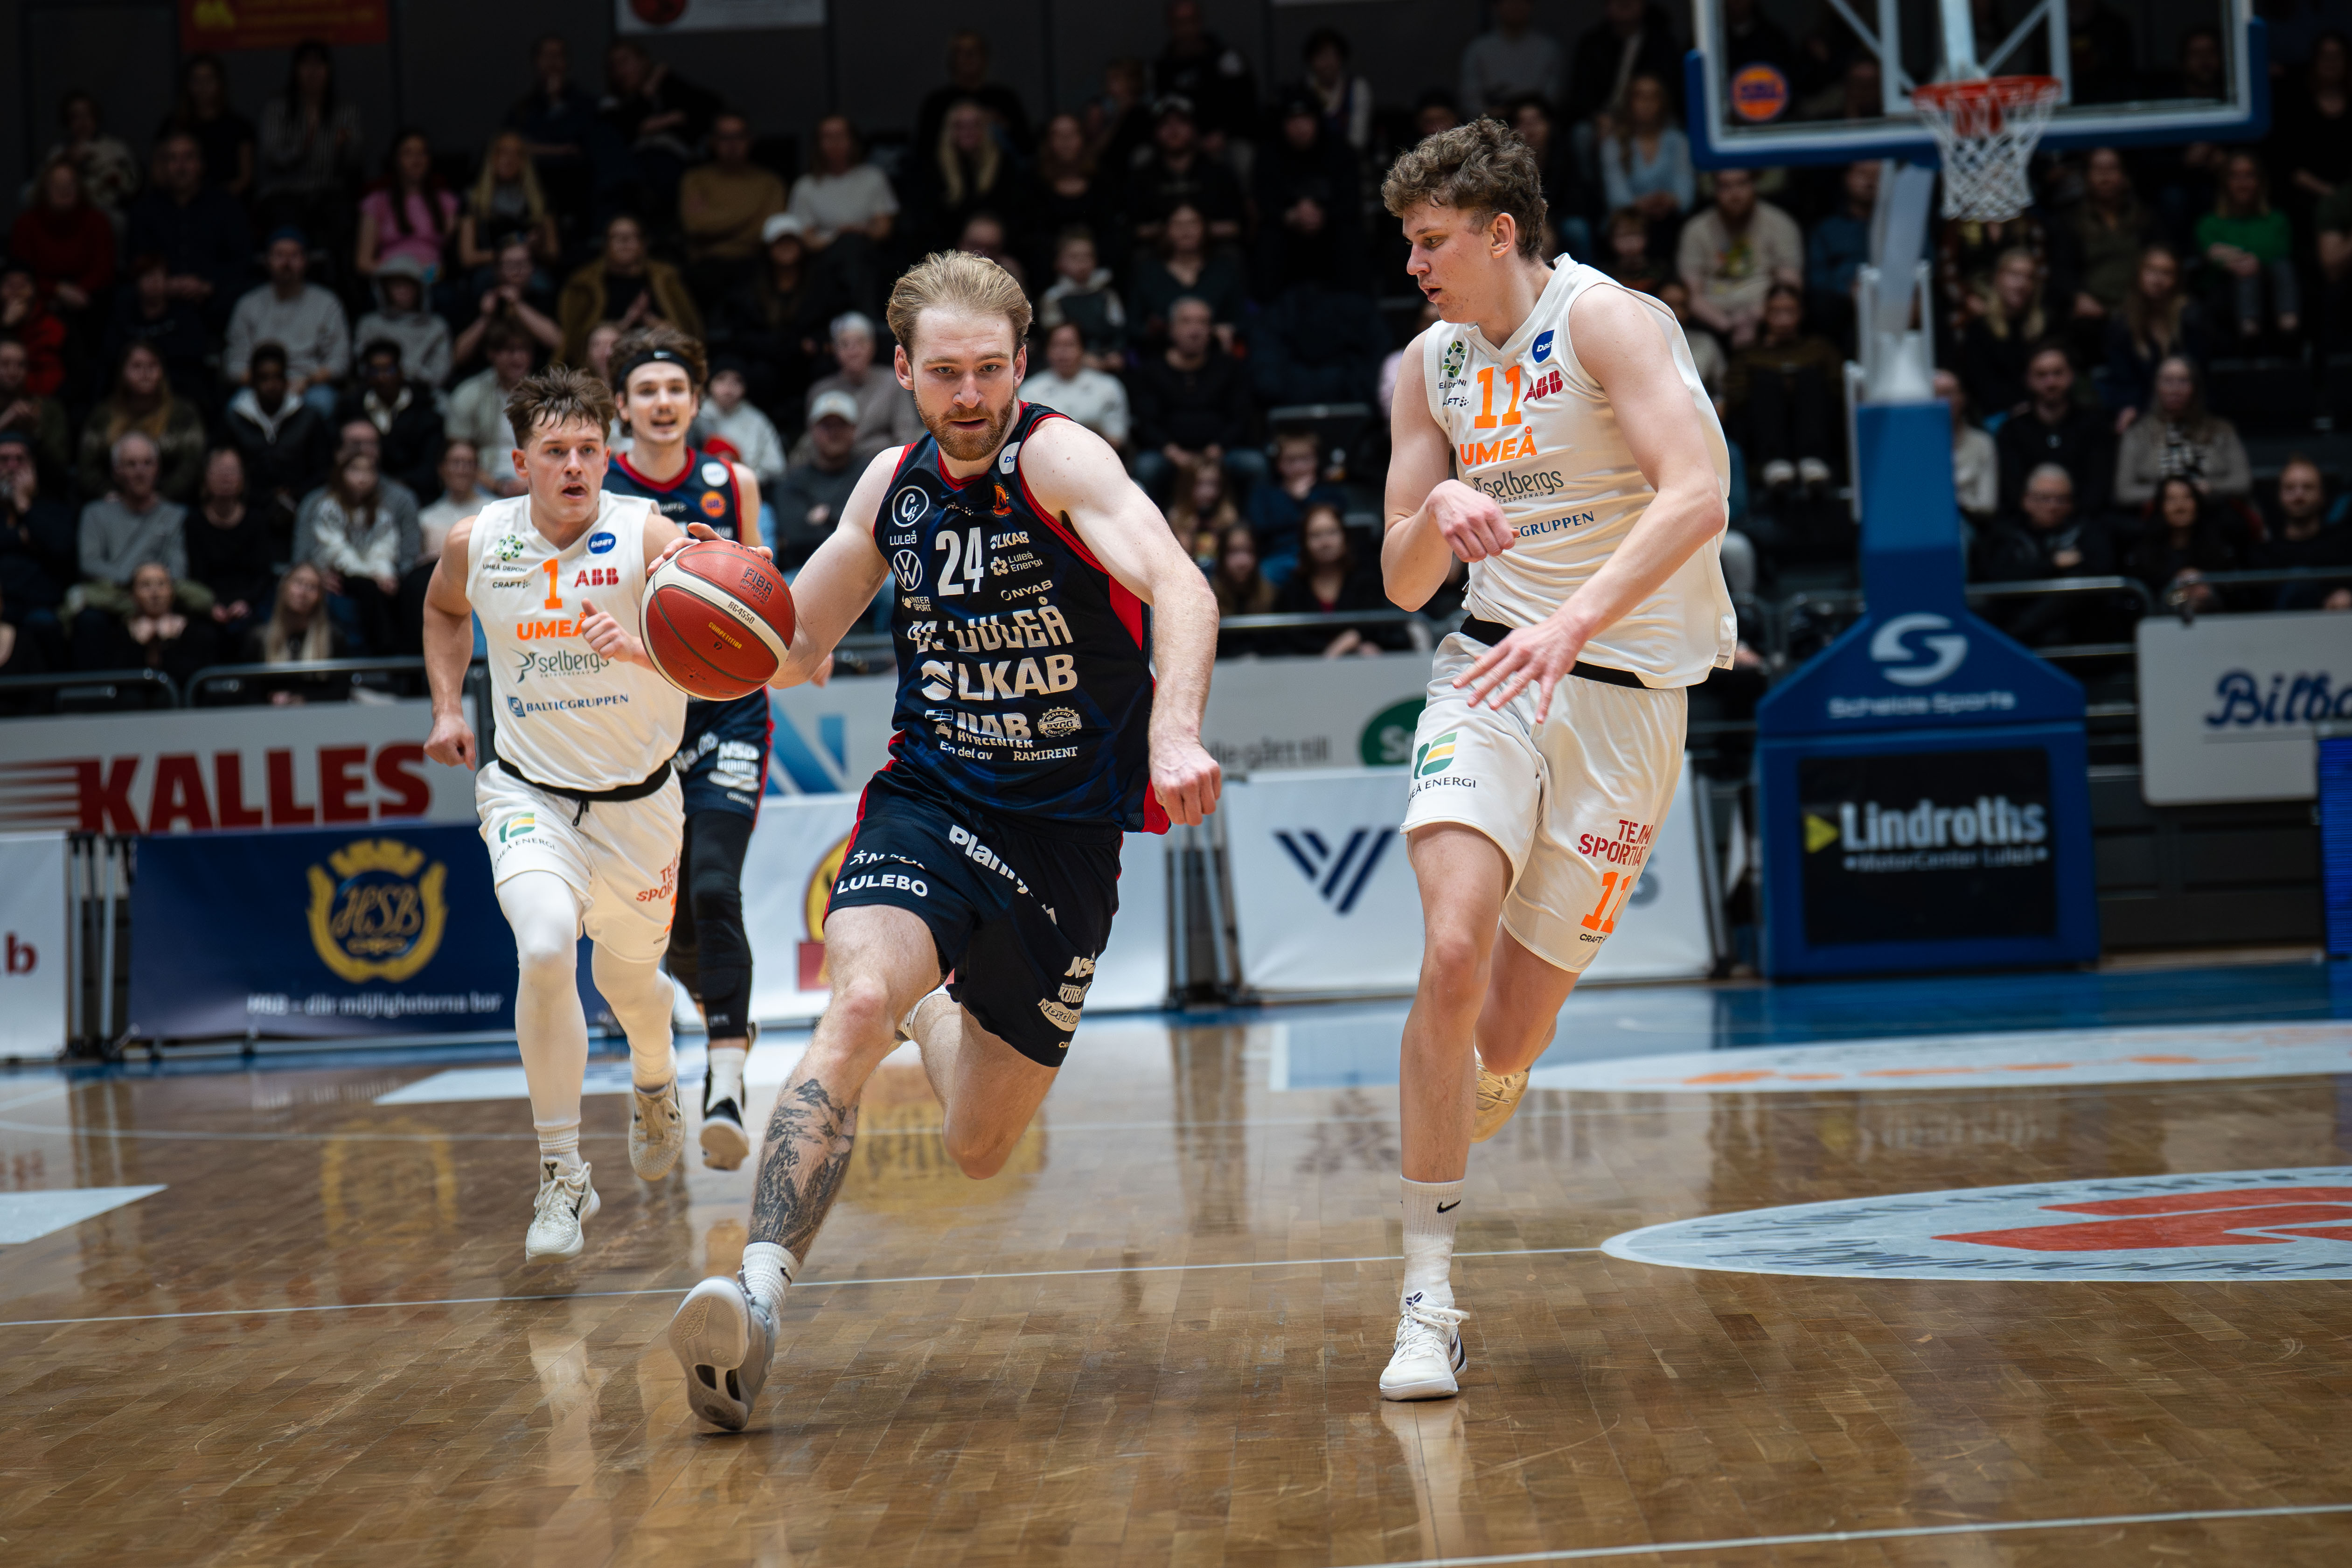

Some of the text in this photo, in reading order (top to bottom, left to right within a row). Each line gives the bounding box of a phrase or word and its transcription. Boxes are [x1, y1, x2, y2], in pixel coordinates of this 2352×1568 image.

[1474, 365, 1522, 429] 11
[1524, 370, 1564, 403] ABB
[1460, 425, 1538, 466] UMEÅ
[1483, 470, 1565, 499] selbergs
[996, 531, 1030, 550] LKAB
[935, 526, 984, 597] 24
[492, 580, 522, 589] CRAFT
[543, 558, 563, 610] 1
[574, 567, 619, 588] ABB
[743, 566, 774, 596] FIBA
[740, 578, 769, 602] APPROVED
[910, 596, 930, 604] INTER
[913, 603, 932, 612] SPORT
[708, 621, 743, 650] COMPETITION
[958, 654, 1078, 701] LKAB
[526, 693, 629, 712] BALTICGRUPPEN
[1046, 720, 1074, 728] BYGG
[939, 741, 994, 760] En del av
[957, 730, 1034, 748] HYRCENTER
[1013, 746, 1079, 761] RAMIRENT
[76, 741, 433, 835] KALLES
[1425, 777, 1476, 789] ENERGI
[1618, 819, 1654, 844] TEAM
[1838, 794, 2048, 852] Lindroths
[515, 837, 556, 850] ENERGI
[836, 874, 928, 897] LULEBO
[1580, 871, 1632, 934] 11
[1579, 934, 1602, 944] CRAFT
